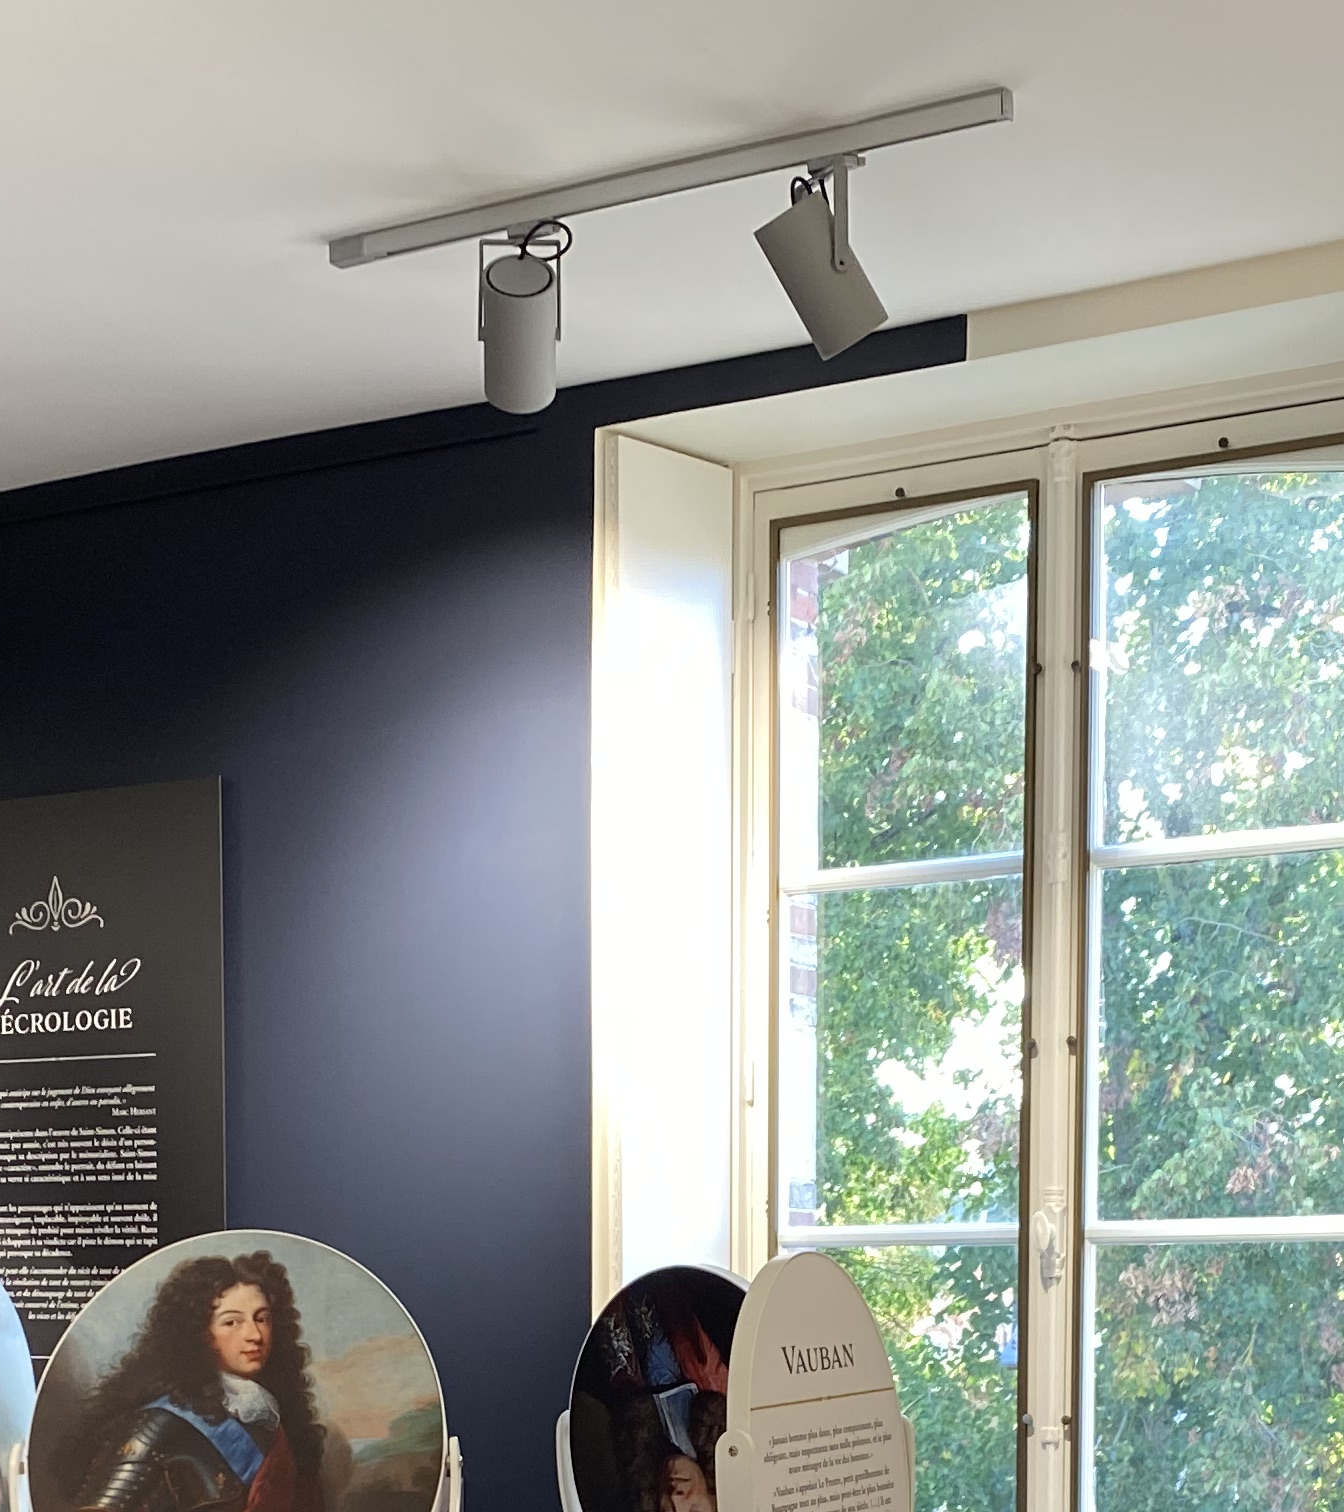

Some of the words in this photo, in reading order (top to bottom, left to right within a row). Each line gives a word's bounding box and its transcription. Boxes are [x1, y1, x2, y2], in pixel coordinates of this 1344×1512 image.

[65, 960, 95, 996] de
[94, 957, 142, 996] la
[781, 1342, 856, 1375] VAUBAN
